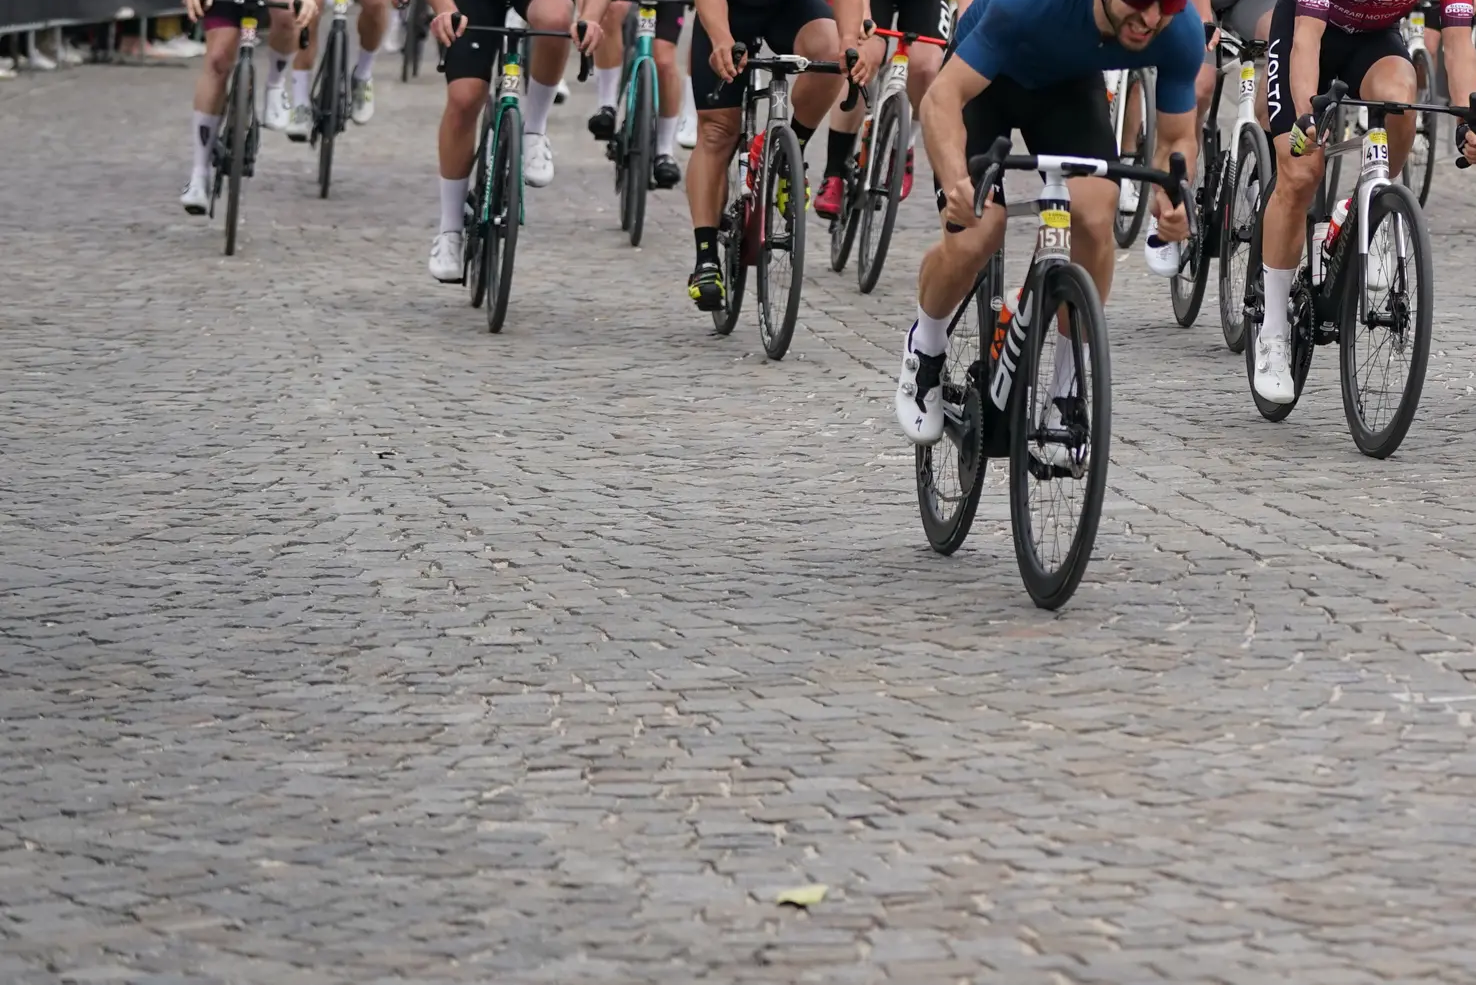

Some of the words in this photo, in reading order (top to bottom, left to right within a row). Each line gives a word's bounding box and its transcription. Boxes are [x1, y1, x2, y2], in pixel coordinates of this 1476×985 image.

[892, 66, 905, 76] 72
[1240, 79, 1254, 93] 33
[1366, 144, 1388, 161] 419
